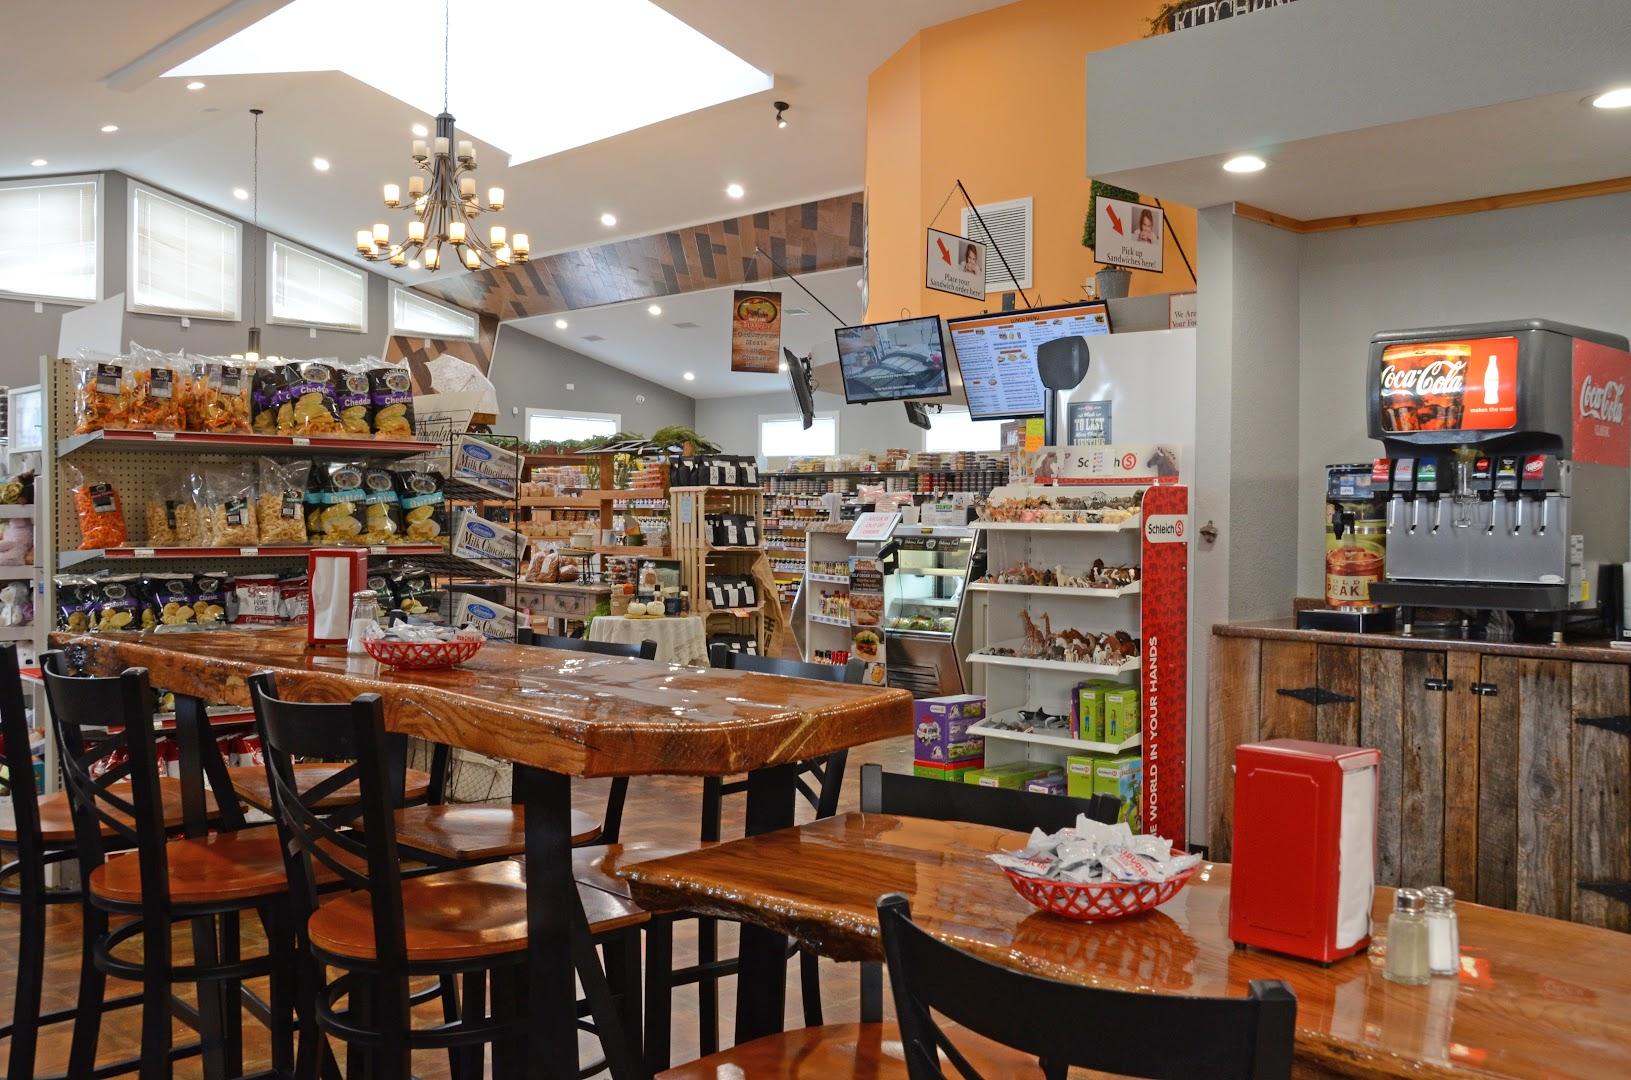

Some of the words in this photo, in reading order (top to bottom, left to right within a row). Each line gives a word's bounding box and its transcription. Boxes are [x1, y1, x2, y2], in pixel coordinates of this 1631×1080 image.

[1106, 252, 1140, 266] Sandwiches
[1141, 259, 1156, 268] here!
[1121, 245, 1134, 256] Pick
[1135, 250, 1143, 258] up
[930, 277, 954, 290] Sandwich
[955, 285, 969, 294] order
[944, 273, 958, 283] Place
[958, 278, 970, 286] your
[1381, 360, 1467, 396] Coca-Cola
[1580, 375, 1624, 424] Coca-Cola
[1074, 419, 1085, 431] TO
[1086, 418, 1104, 431] LAST
[460, 454, 478, 471] Milk
[331, 491, 365, 503] Butter
[410, 493, 442, 509] Butter
[1148, 523, 1175, 535] Schleich
[463, 531, 480, 550] Milk
[1149, 636, 1158, 692] HANDS
[1149, 696, 1158, 741] YOUR
[1149, 743, 1158, 761] IN
[1149, 764, 1158, 821] WORLD
